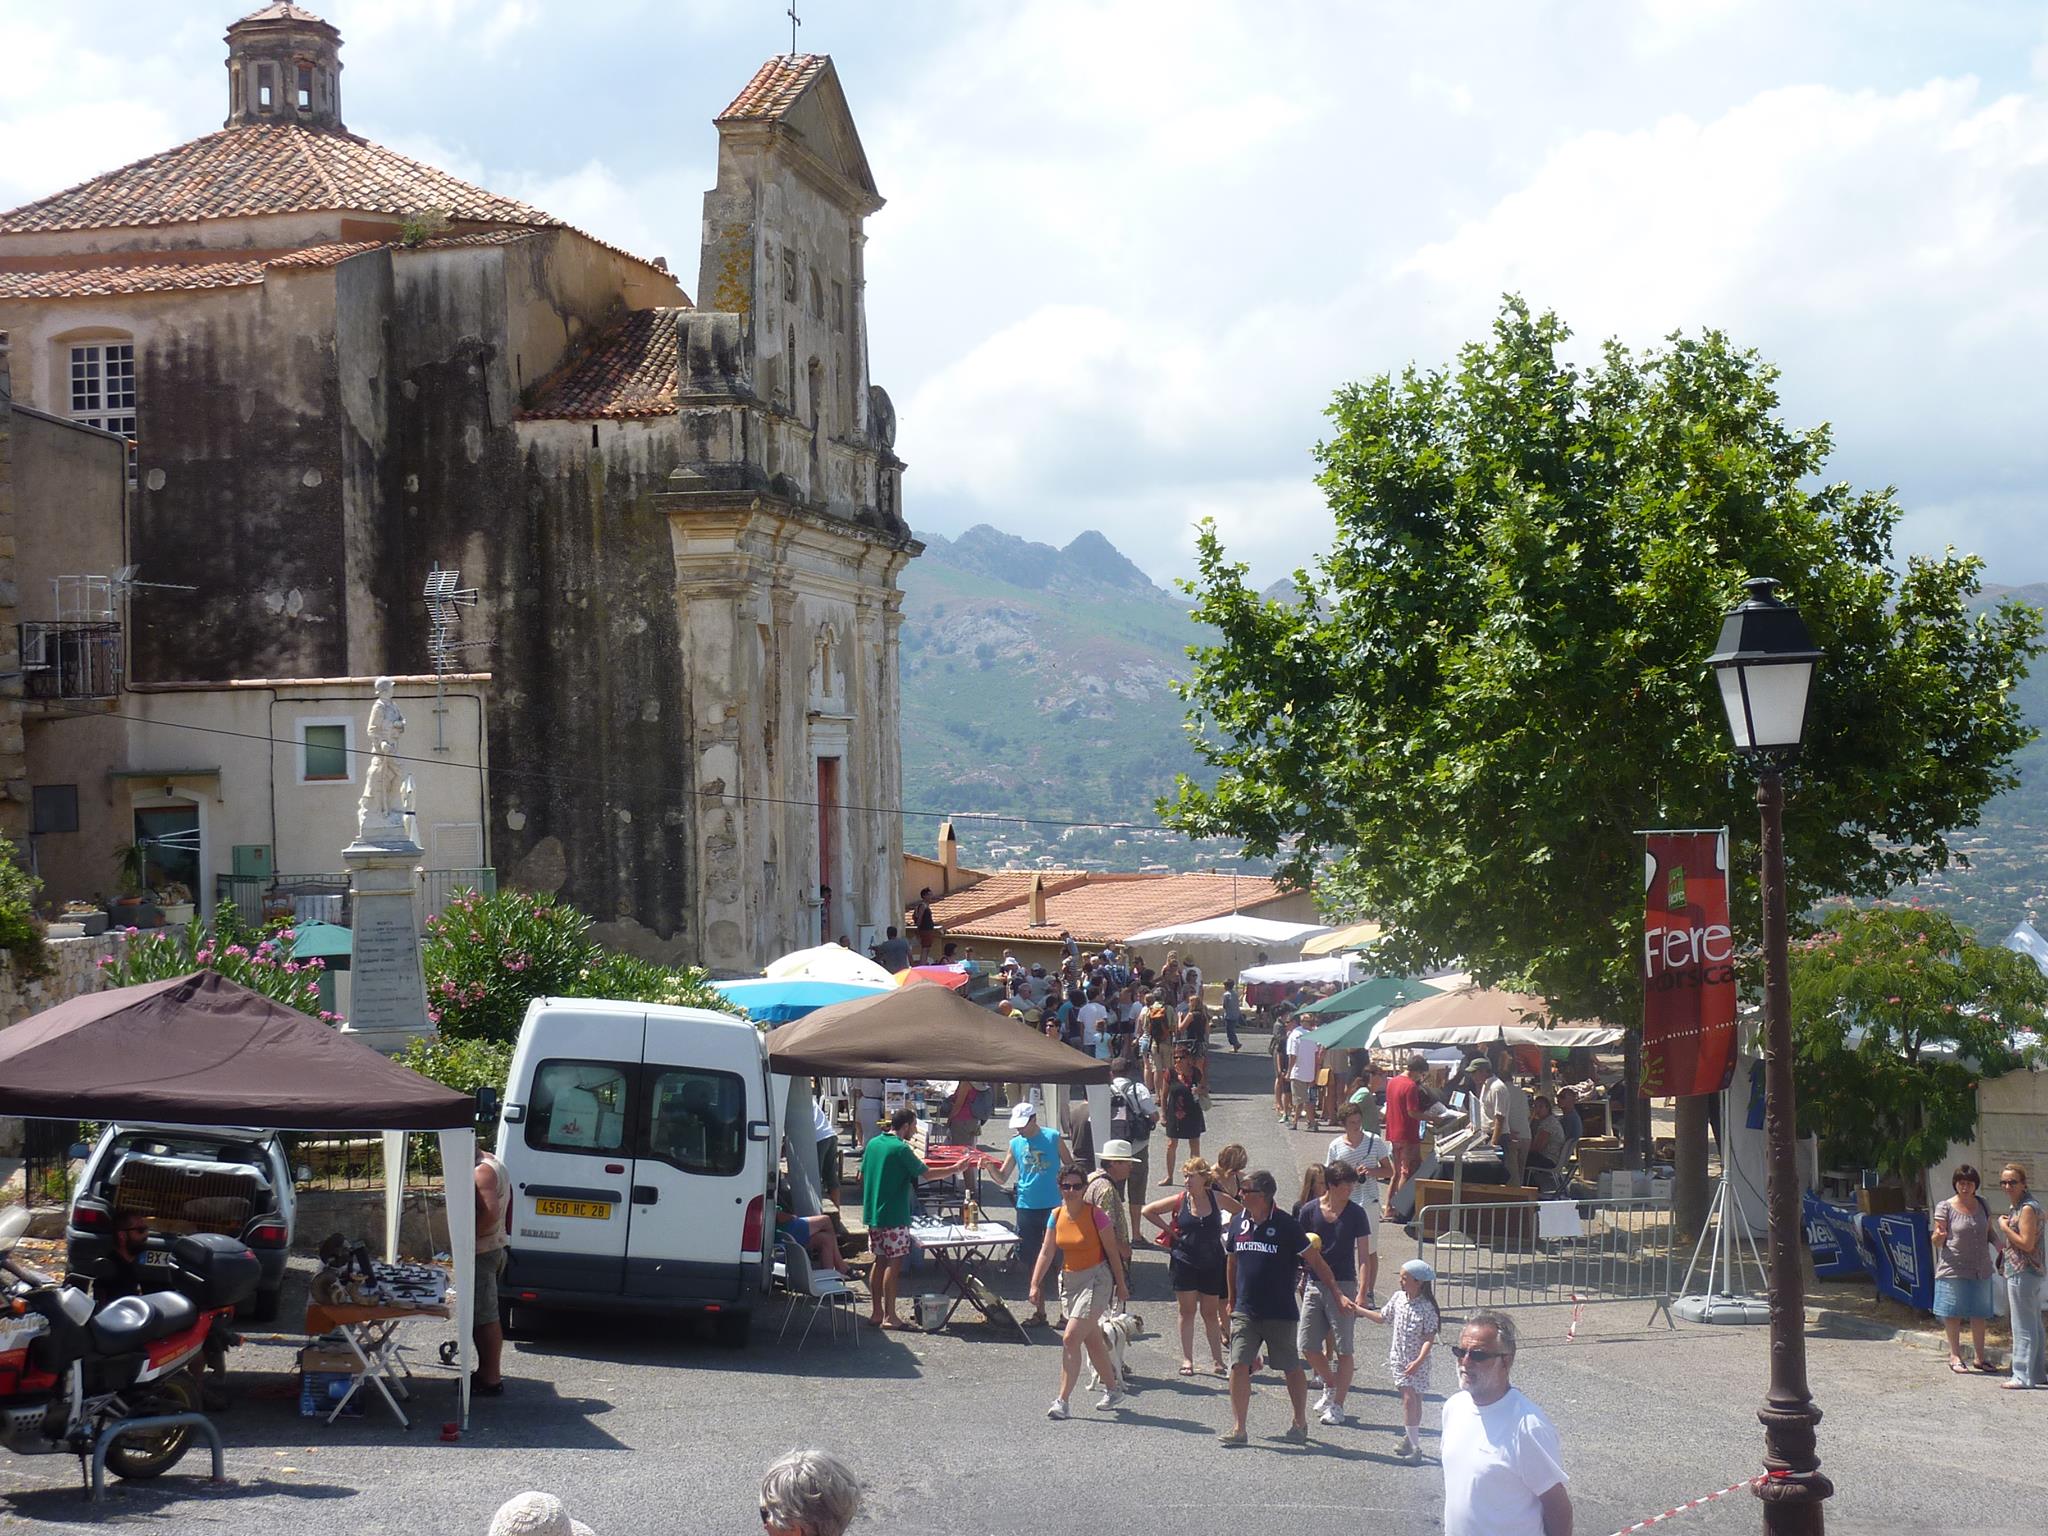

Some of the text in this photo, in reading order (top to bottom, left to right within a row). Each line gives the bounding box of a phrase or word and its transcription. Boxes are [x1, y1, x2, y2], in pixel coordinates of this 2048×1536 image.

[1644, 924, 1732, 978] Fiere
[542, 1201, 568, 1214] 4560
[573, 1203, 586, 1215] HC
[1240, 1219, 1250, 1235] 9
